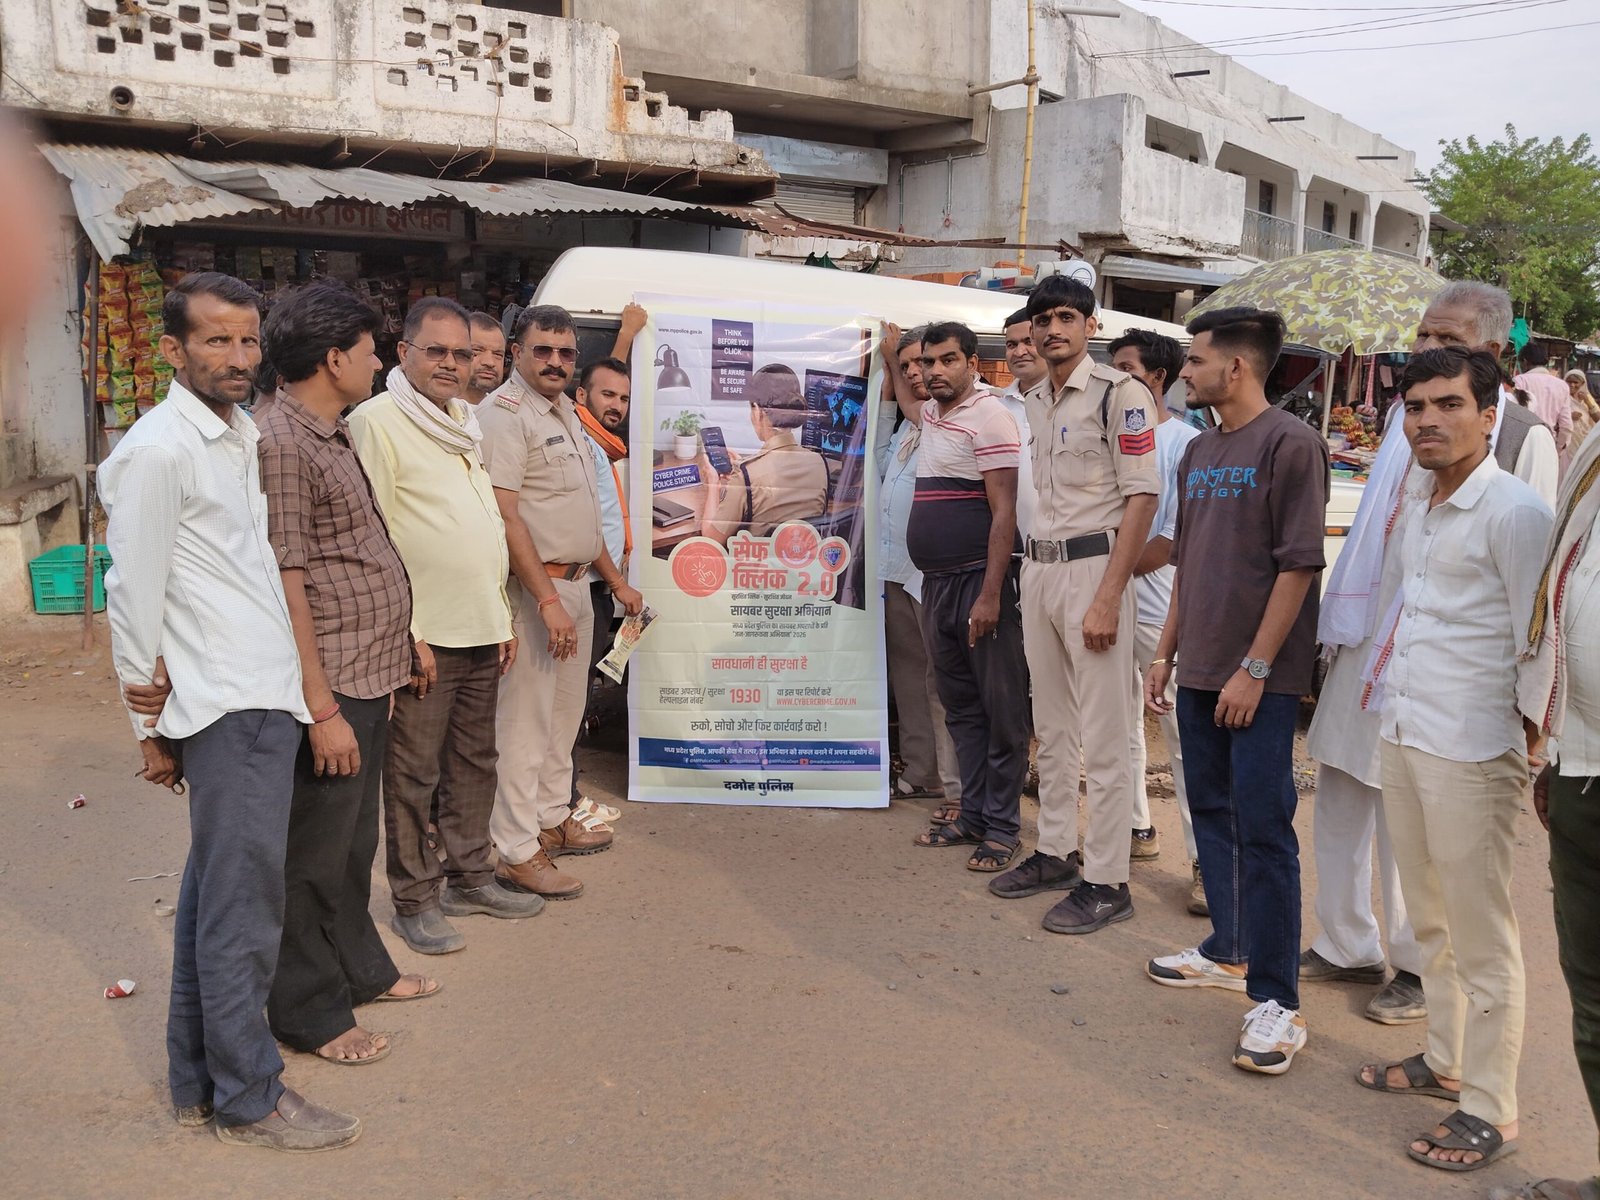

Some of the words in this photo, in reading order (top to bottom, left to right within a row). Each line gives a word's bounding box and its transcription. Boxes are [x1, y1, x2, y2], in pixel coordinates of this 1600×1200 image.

[723, 347, 742, 355] CLICK
[654, 471, 673, 480] CYBER
[674, 468, 691, 476] CRIME
[653, 479, 674, 489] POLICE
[675, 475, 696, 485] STATION
[732, 535, 770, 561] सेफ
[732, 562, 788, 589] क्लिक
[797, 571, 834, 596] 2.0
[730, 605, 763, 616] सायबर
[764, 606, 792, 619] सुरक्षा
[794, 603, 832, 616] अभियान
[712, 655, 754, 670] सावधानी
[757, 655, 767, 670] ही
[770, 658, 799, 673] सुरक्षा
[801, 656, 808, 670] है
[707, 688, 725, 697] सुरक्षा
[730, 688, 760, 704] 1930
[776, 688, 783, 696] या
[784, 688, 794, 696] इस
[795, 688, 803, 696] पर
[804, 687, 820, 696] रिपोर्ट
[821, 687, 832, 696] करें
[659, 695, 688, 704] हेल्पलाइन
[776, 698, 857, 706] WWW.CYBERCRIME.GOV.IN
[691, 719, 712, 732] रुको,
[714, 718, 735, 731] सोचो
[737, 718, 753, 731] और
[755, 718, 771, 731] फिर
[773, 718, 804, 732] कार्रवाई
[805, 719, 821, 732] करो
[789, 747, 797, 755] को
[723, 778, 755, 791] दमोह
[758, 778, 794, 796] पुलिस
